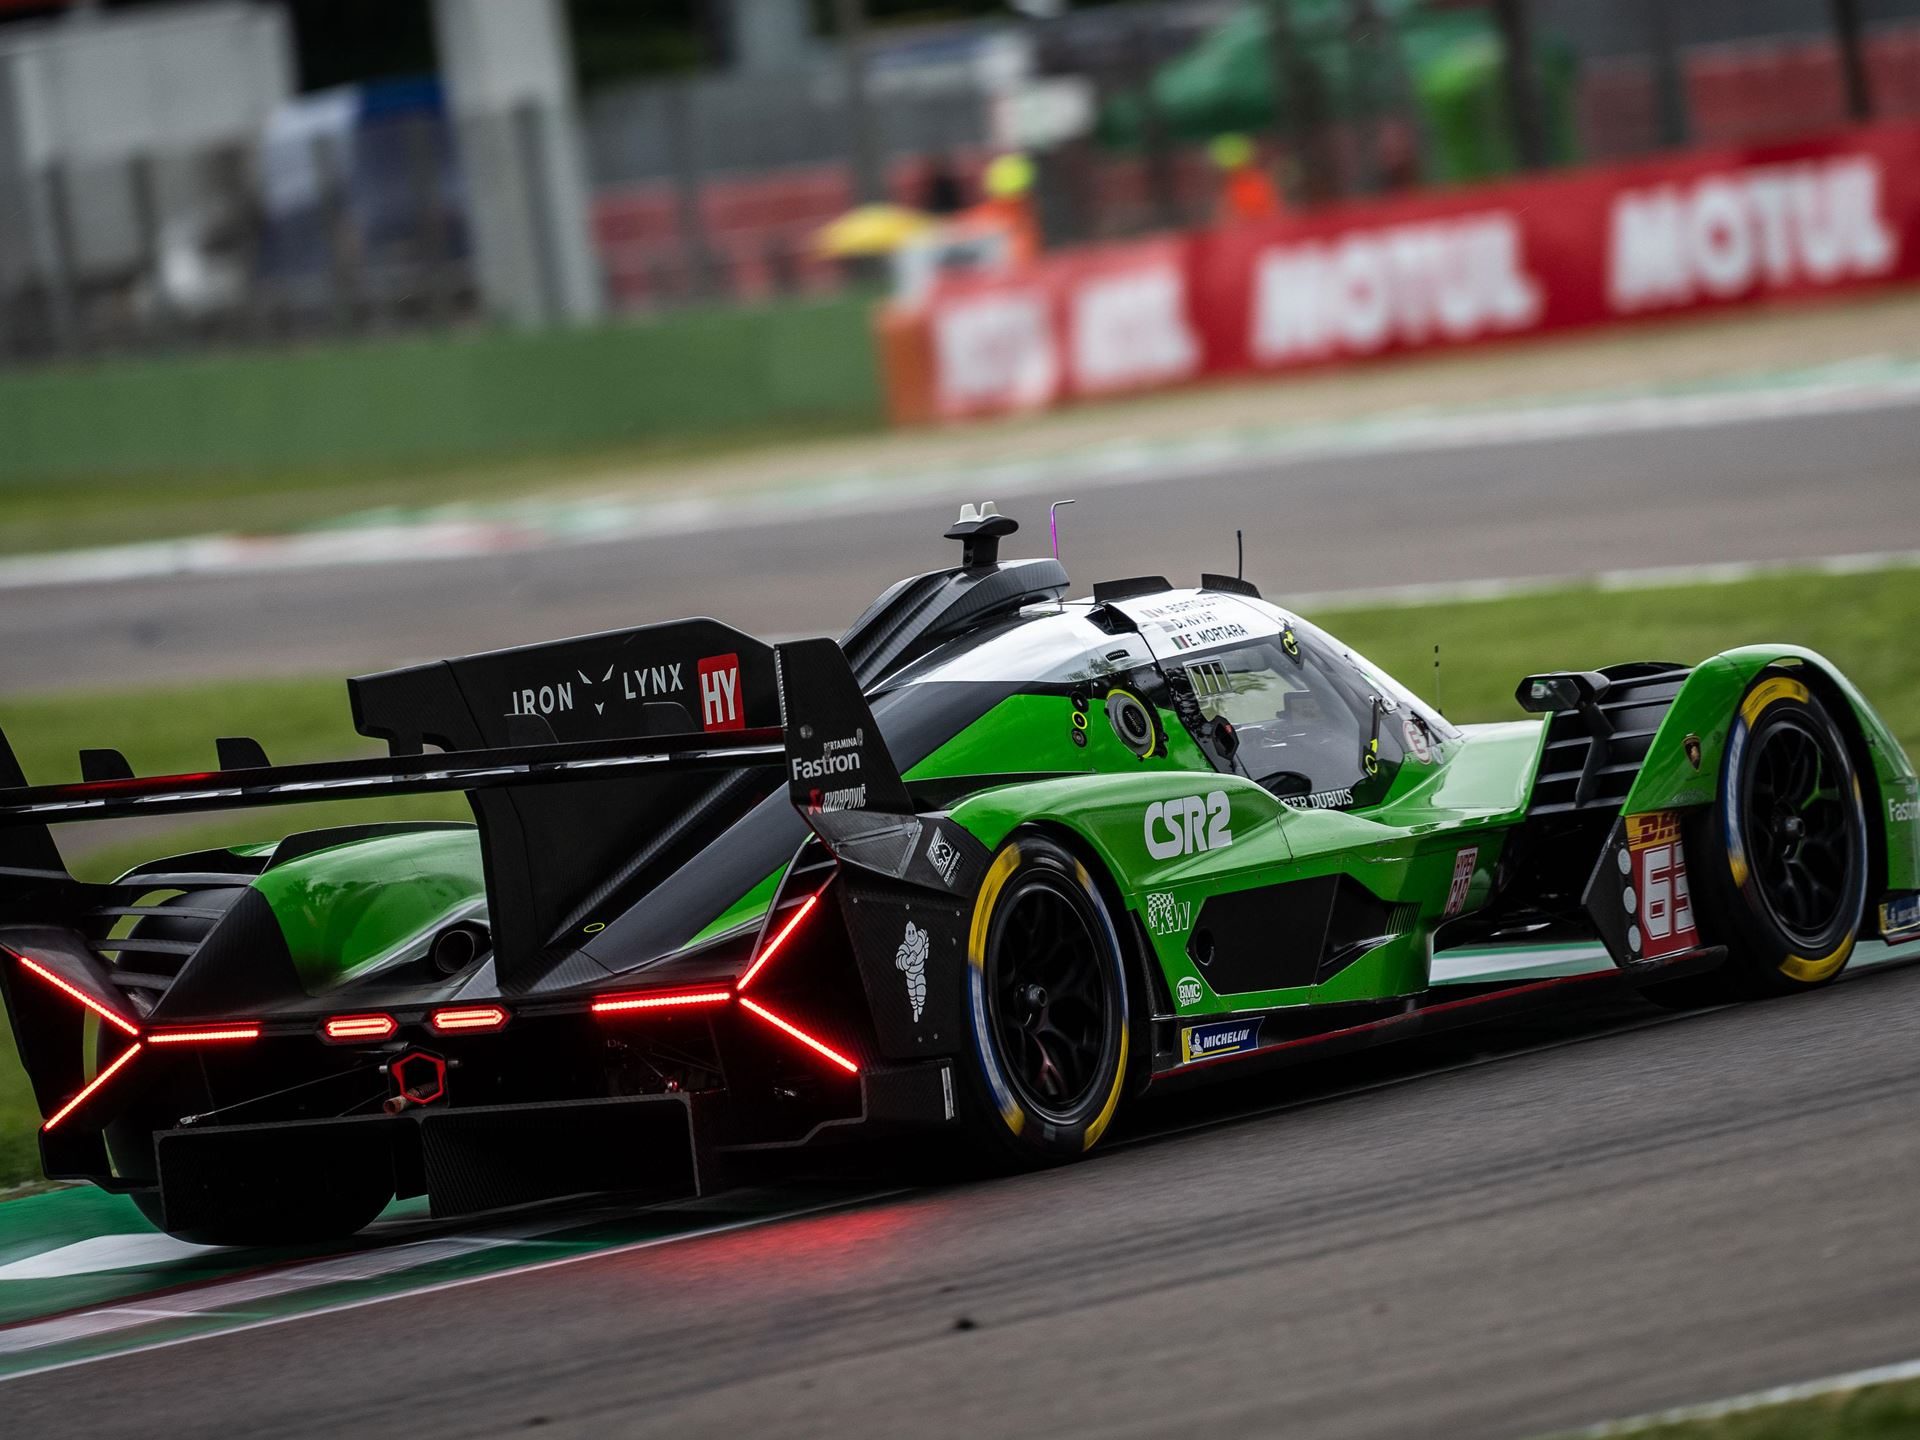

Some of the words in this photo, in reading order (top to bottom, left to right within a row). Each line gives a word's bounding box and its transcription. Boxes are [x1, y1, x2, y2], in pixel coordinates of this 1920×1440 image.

[1610, 157, 1896, 312] MOTUL
[1185, 633, 1200, 647] E.
[1200, 623, 1249, 644] MORTARA
[512, 682, 574, 715] IRON
[623, 663, 684, 700] LYNX
[701, 668, 737, 725] HY
[823, 737, 858, 751] PERTAMINA
[792, 751, 861, 780] Fastron
[1309, 788, 1354, 809] DUBUIS
[1144, 790, 1233, 860] CSR2
[1156, 901, 1191, 935] KW
[1178, 983, 1200, 999] BMC
[1203, 1029, 1250, 1049] MICHELIN
